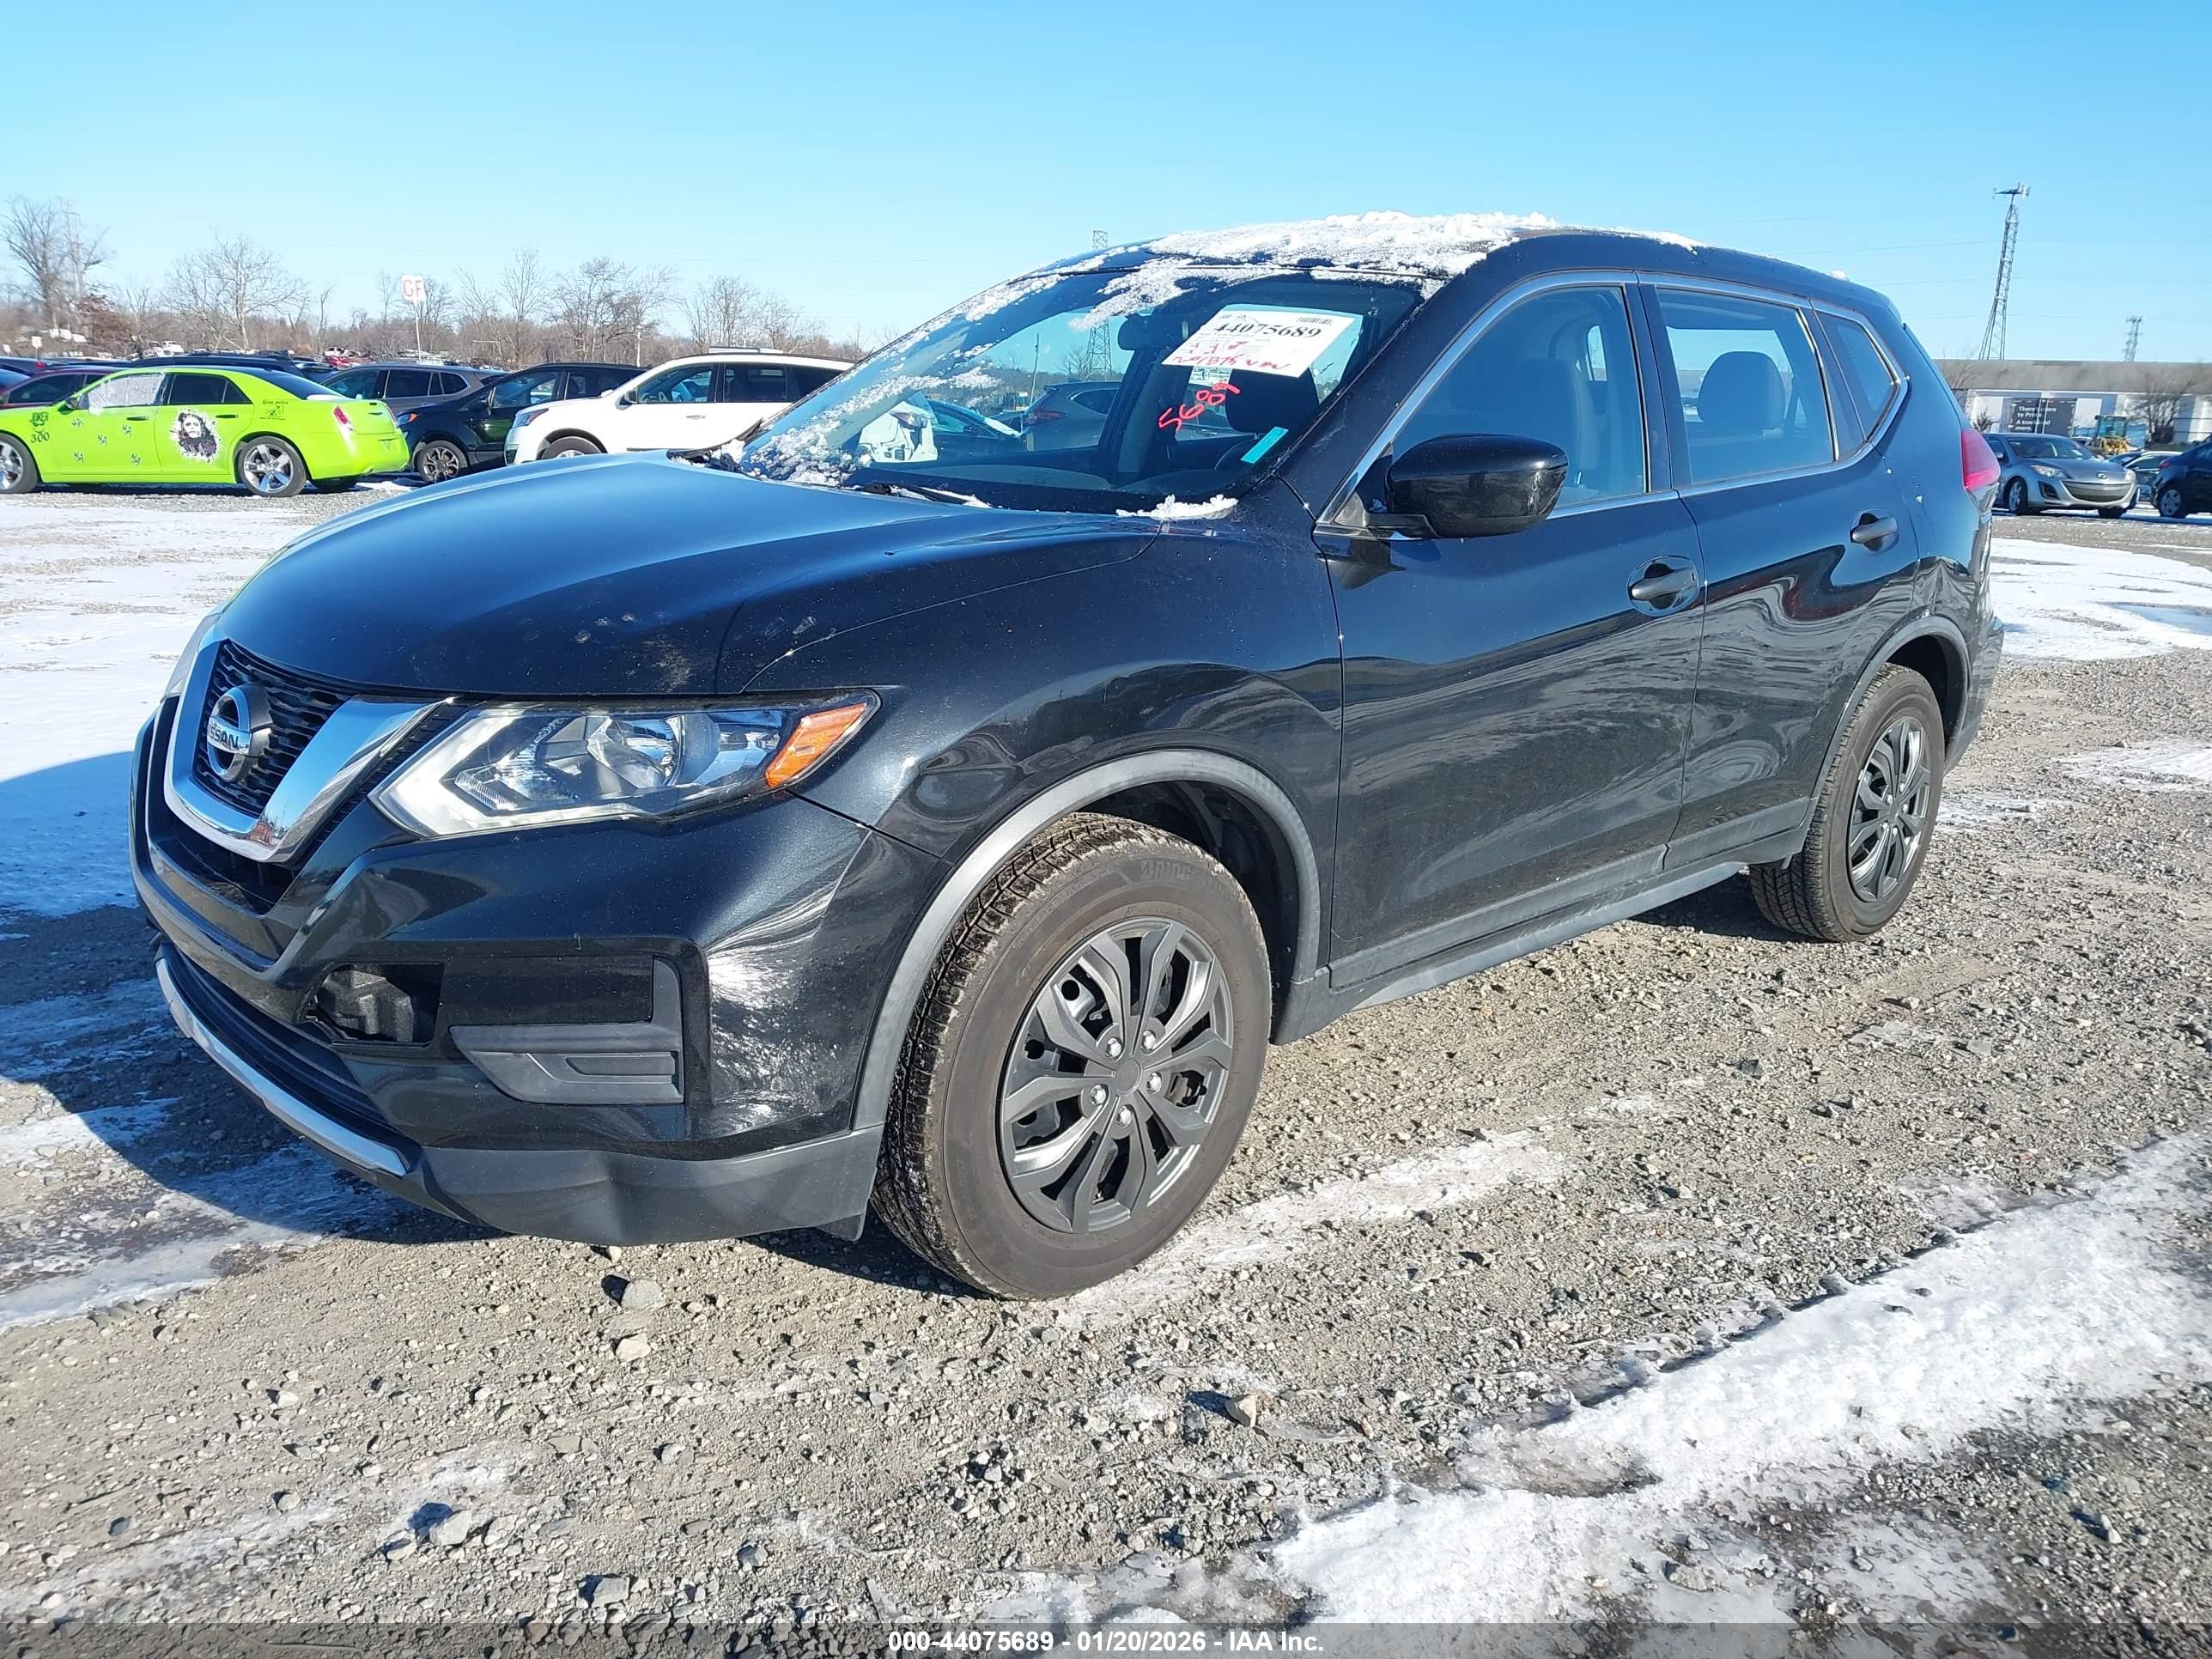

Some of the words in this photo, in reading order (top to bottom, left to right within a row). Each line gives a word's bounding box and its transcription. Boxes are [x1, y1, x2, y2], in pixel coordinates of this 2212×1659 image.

[1212, 322, 1322, 338] 44075689
[1158, 381, 1241, 431] 5689
[30, 431, 50, 444] 300
[208, 725, 240, 750] SSAN
